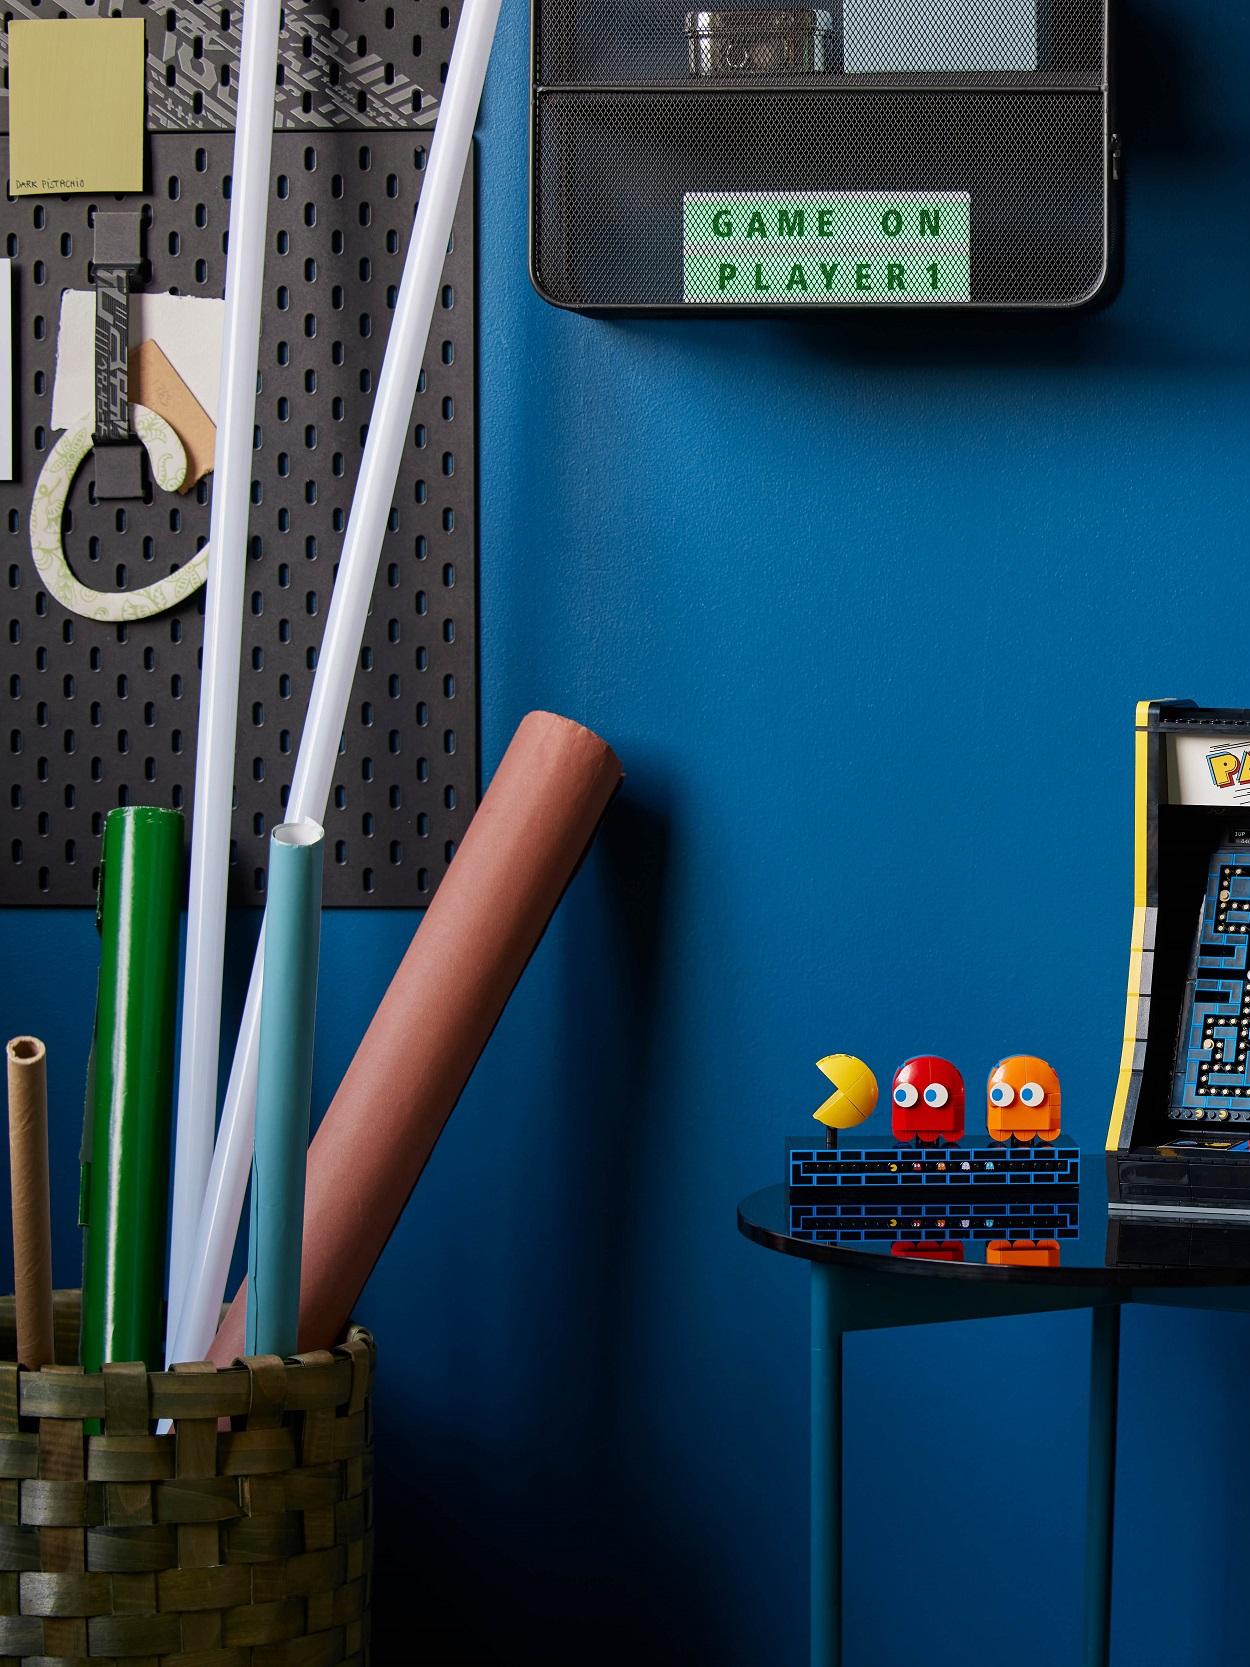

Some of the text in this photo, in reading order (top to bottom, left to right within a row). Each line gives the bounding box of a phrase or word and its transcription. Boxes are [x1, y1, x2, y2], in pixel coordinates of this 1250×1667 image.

[16, 179, 38, 190] DARK
[711, 208, 941, 238] GAME ON
